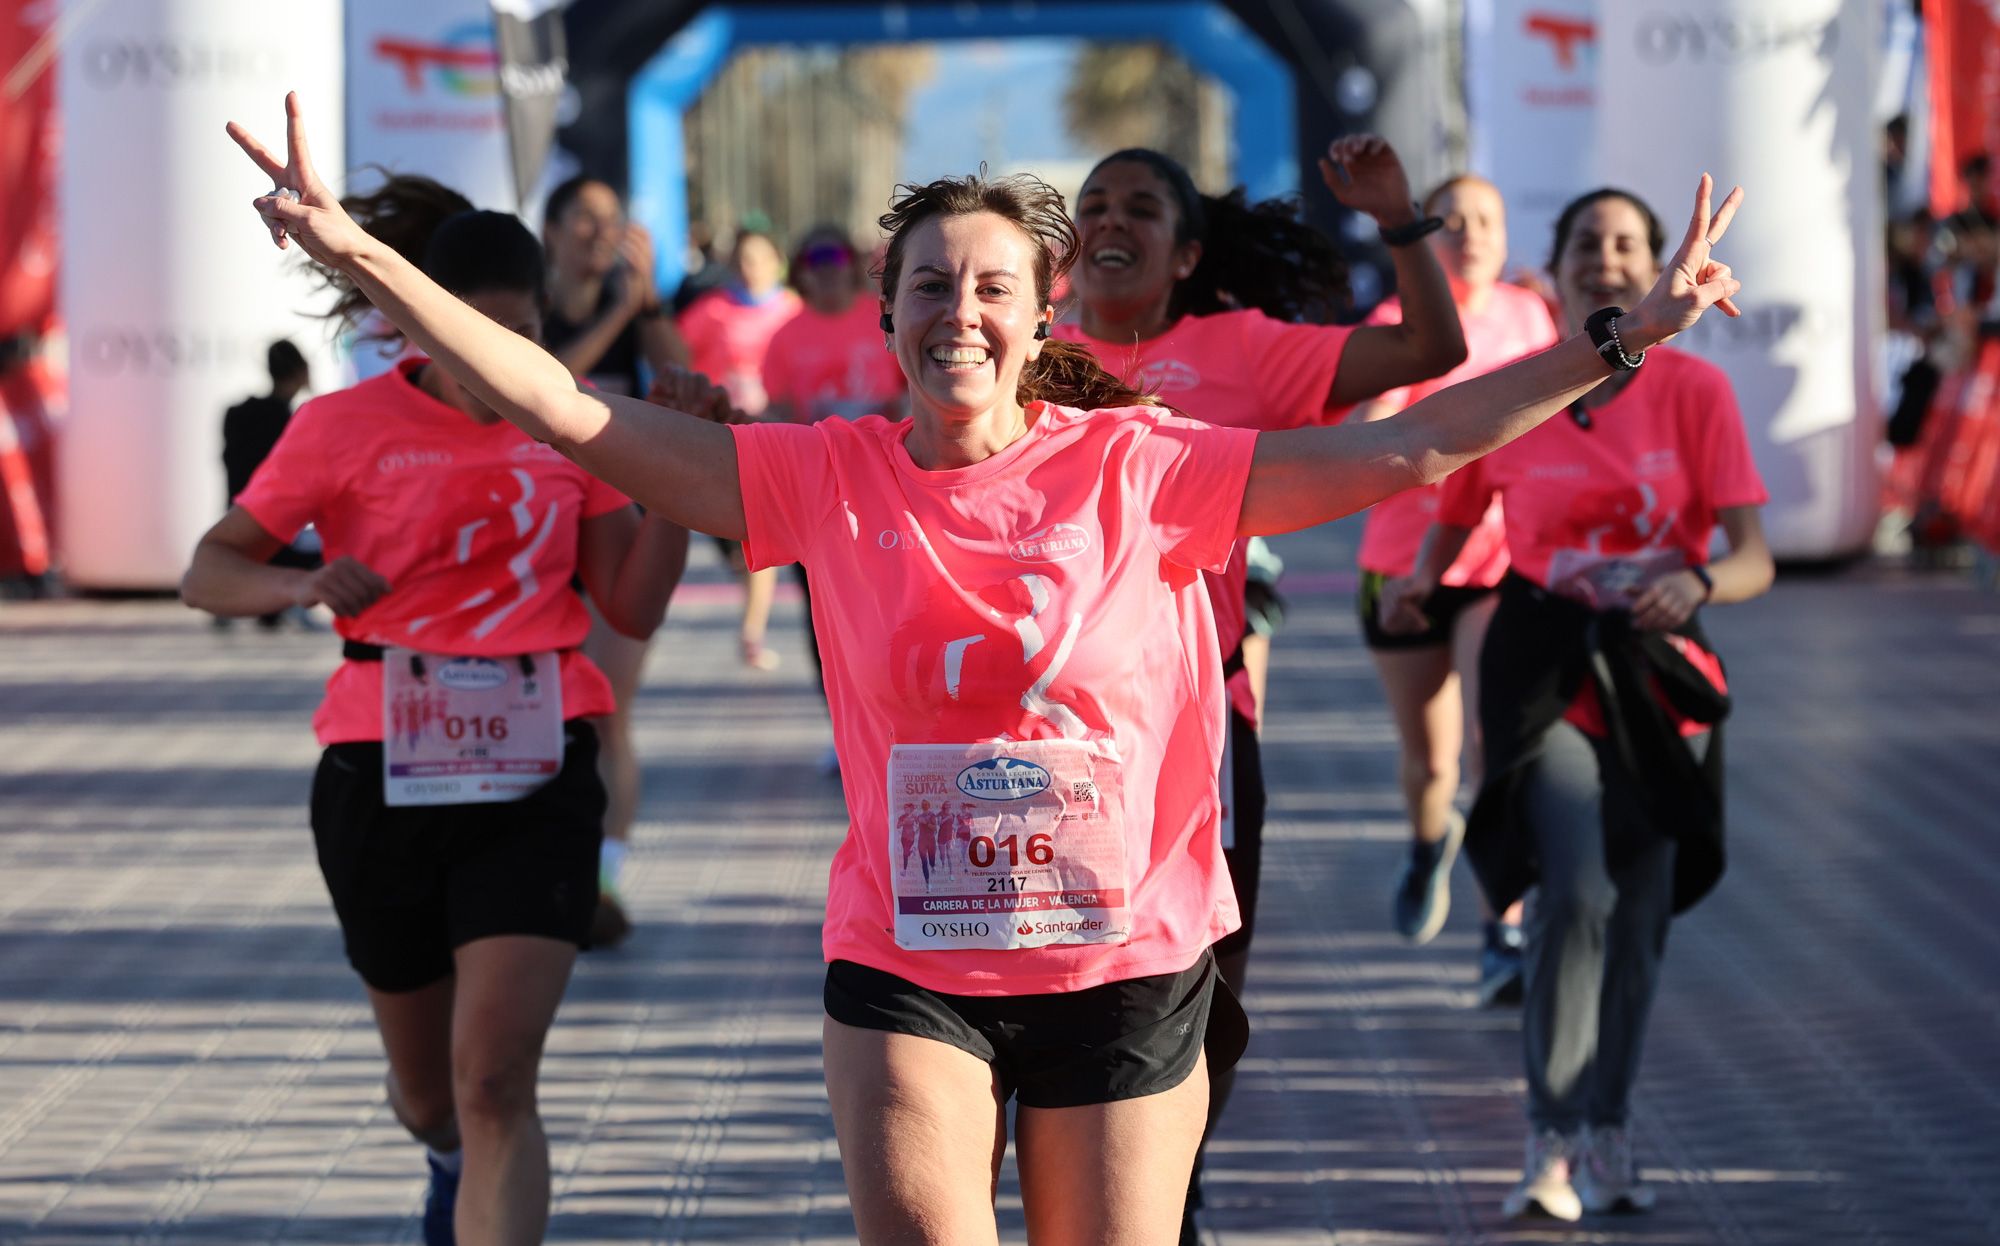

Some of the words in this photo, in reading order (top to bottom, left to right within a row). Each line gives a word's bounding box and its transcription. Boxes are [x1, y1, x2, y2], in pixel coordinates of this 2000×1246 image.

[377, 450, 453, 474] OYSHO
[1017, 536, 1085, 558] ASTURIANA
[445, 714, 508, 741] 016
[903, 775, 913, 783] TU
[914, 775, 946, 783] DORSAL
[963, 773, 1044, 790] ASTURIANA
[905, 783, 948, 796] SUMA
[968, 832, 1054, 868] 016
[987, 876, 1027, 892] 2117
[923, 899, 969, 911] CARRERA
[972, 899, 984, 910] DE
[987, 899, 1001, 909] LA
[1003, 896, 1039, 909] MUJER
[1049, 893, 1098, 906] VALENCIA
[922, 922, 990, 937] OYSHO
[1035, 918, 1103, 934] Santander
